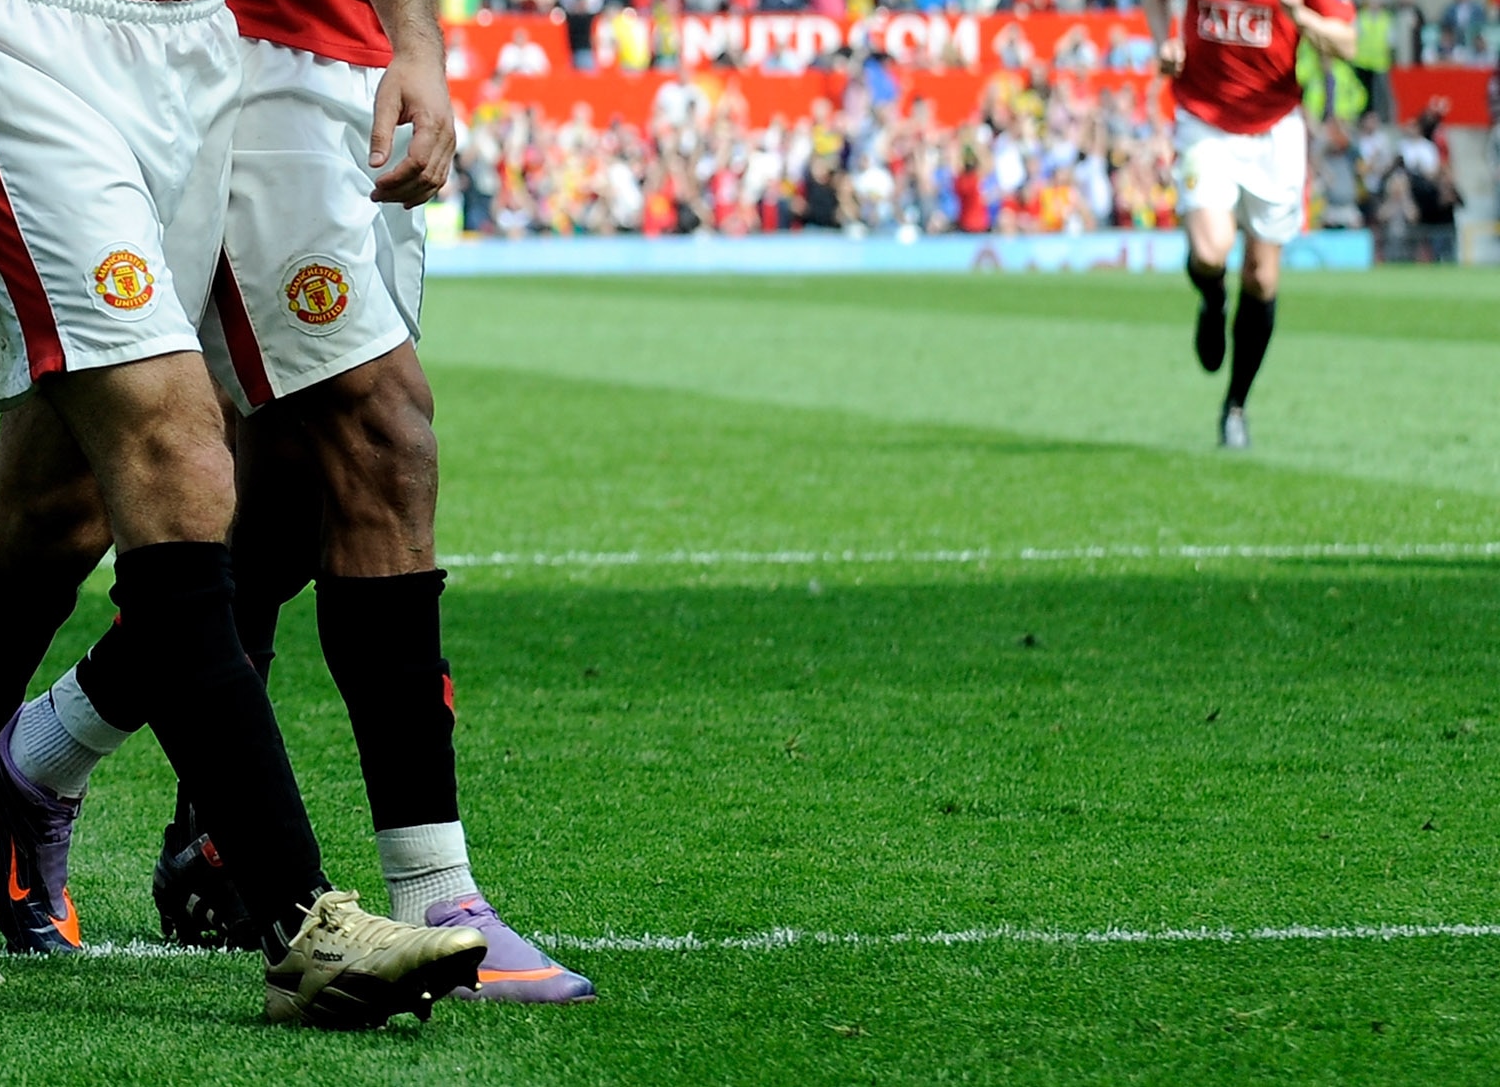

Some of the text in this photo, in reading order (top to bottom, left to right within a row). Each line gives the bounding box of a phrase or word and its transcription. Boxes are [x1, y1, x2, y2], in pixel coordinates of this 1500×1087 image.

[1200, 1, 1270, 44] AIG
[97, 253, 145, 279] MANCHESTER
[289, 267, 340, 296] MANCHESTER
[114, 292, 149, 306] UNITED
[308, 304, 342, 322] UNITED
